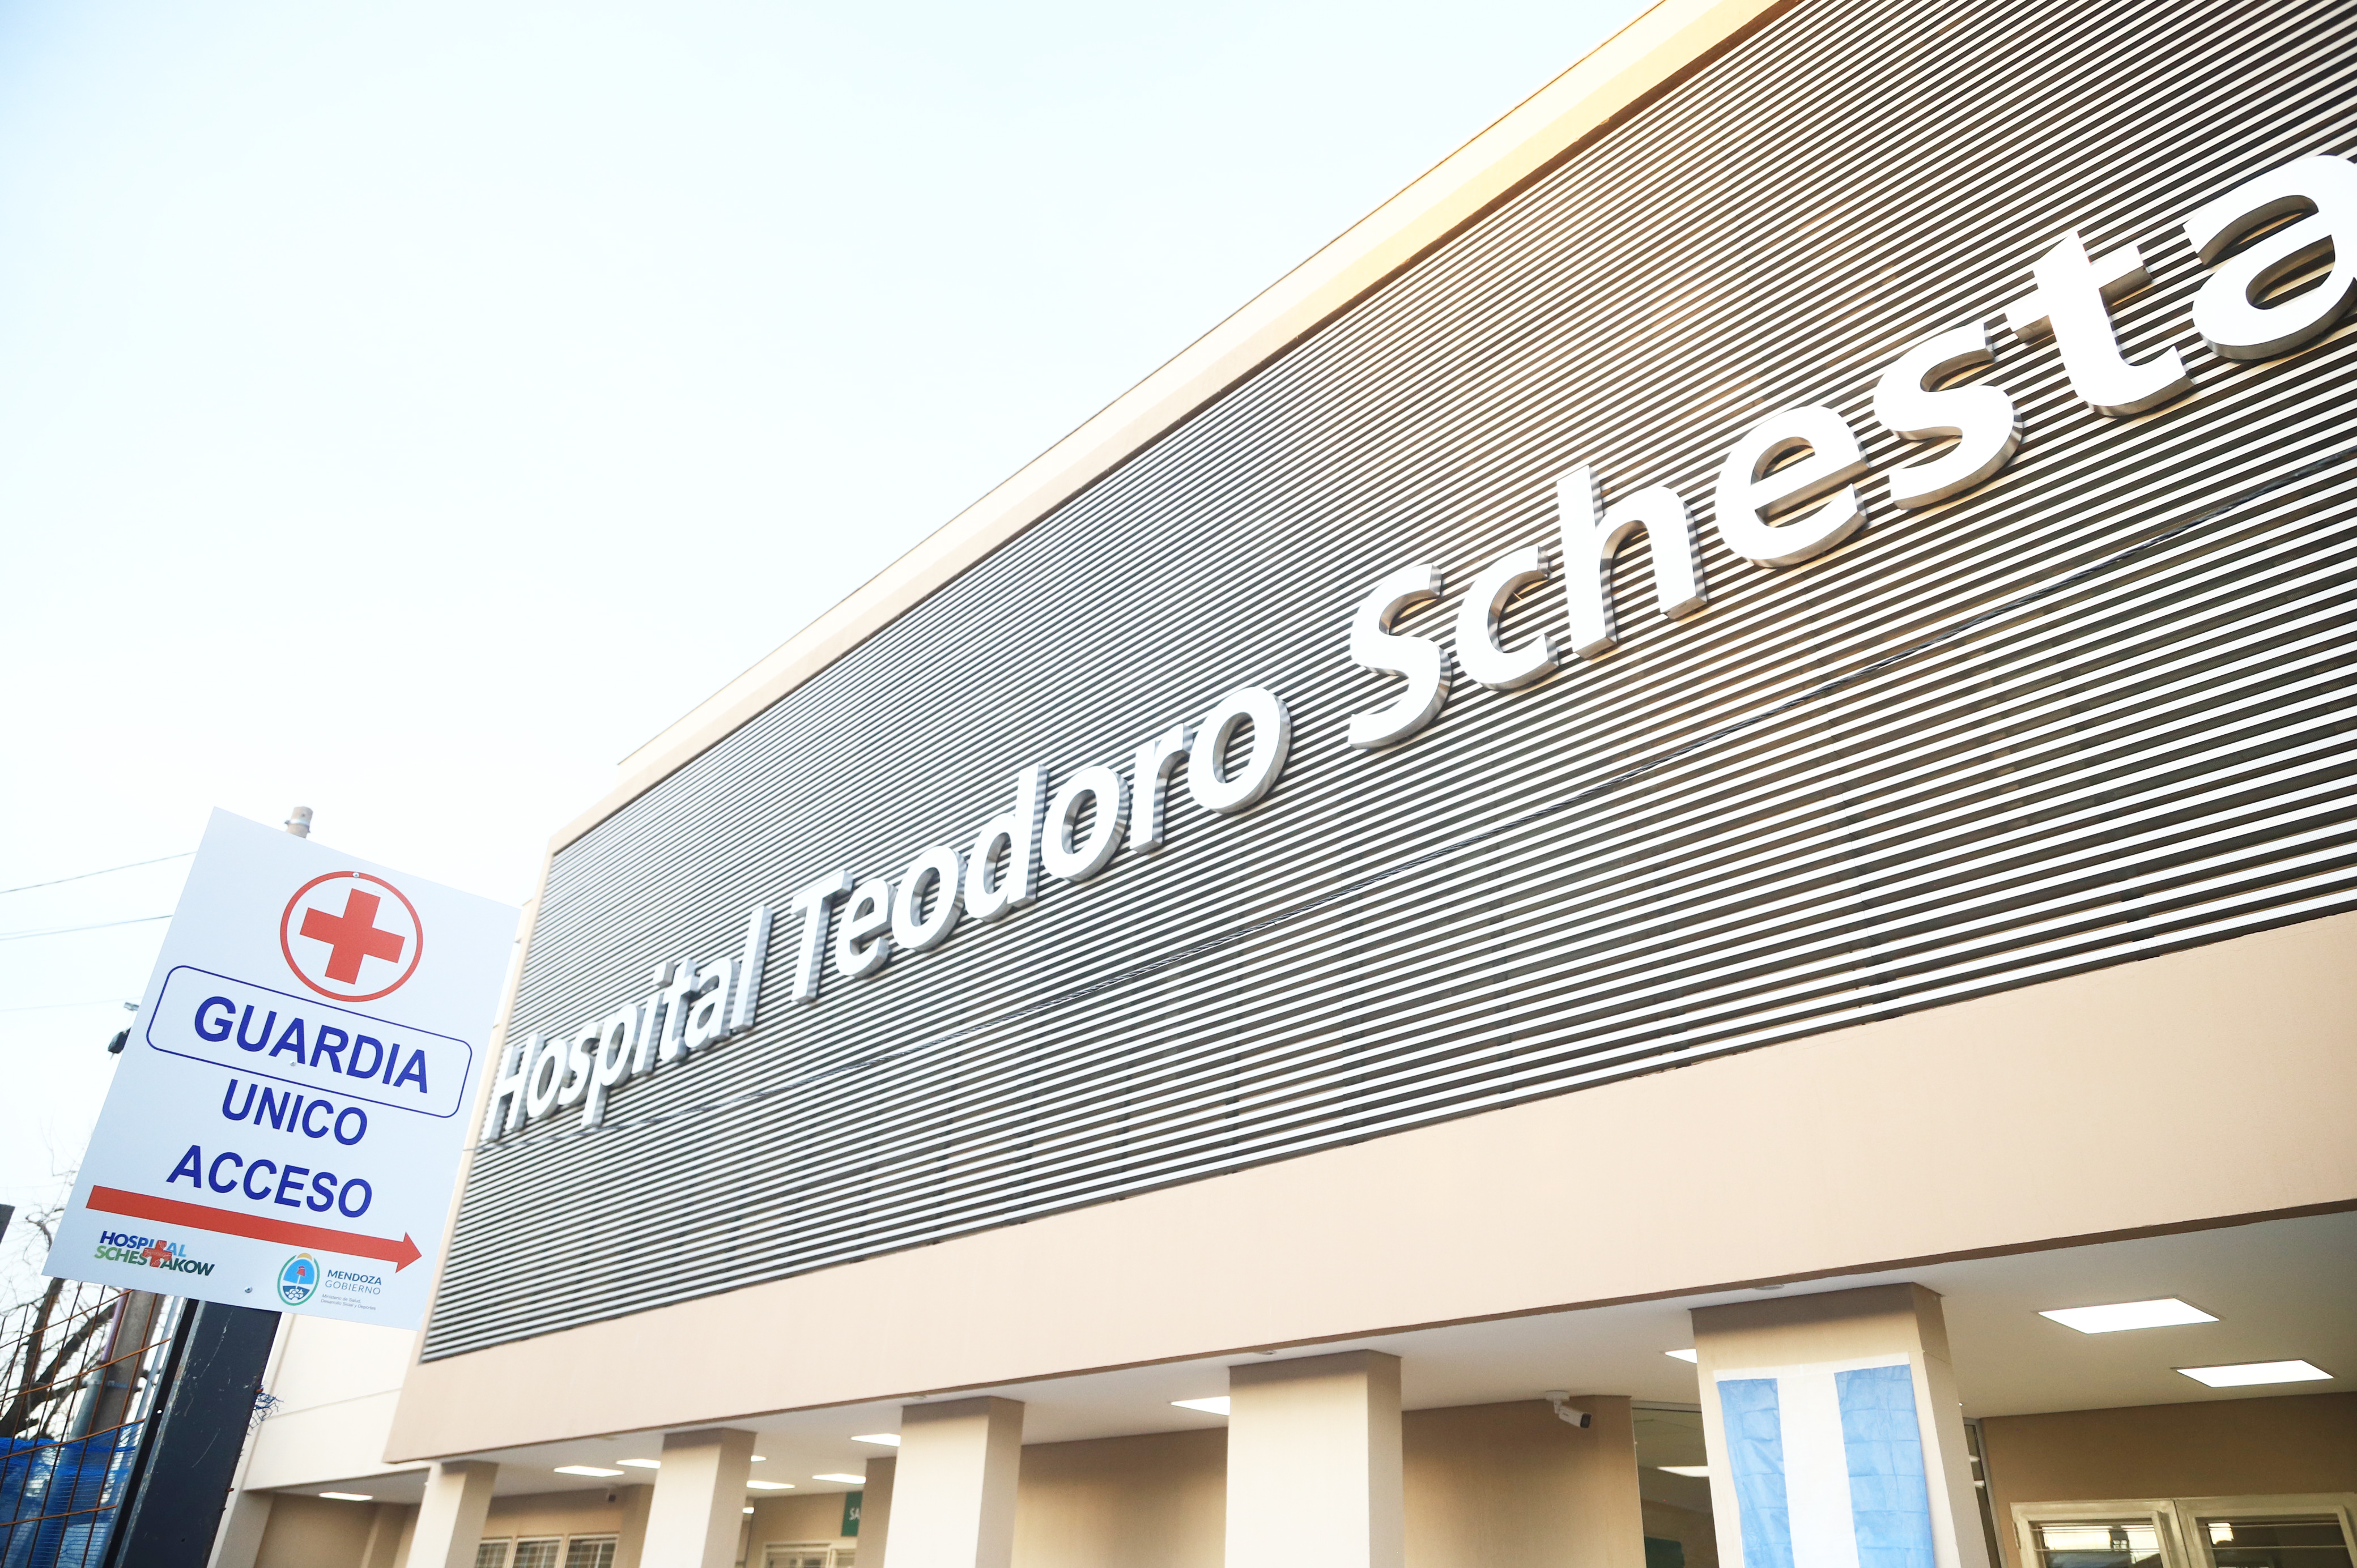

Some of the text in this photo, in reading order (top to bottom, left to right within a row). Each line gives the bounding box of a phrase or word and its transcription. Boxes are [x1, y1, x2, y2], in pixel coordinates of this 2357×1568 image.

[481, 905, 773, 1143] Hospital
[791, 686, 1292, 1004] Teodoro
[194, 996, 428, 1094] GUARDIA
[222, 1079, 368, 1146] UNICO
[166, 1144, 373, 1218] ACCESO
[94, 1245, 215, 1276] SCHESAKOW
[99, 1230, 186, 1258] HOSPIAL
[325, 1280, 381, 1295] GOBIERNO
[327, 1269, 382, 1285] MENDOZA
